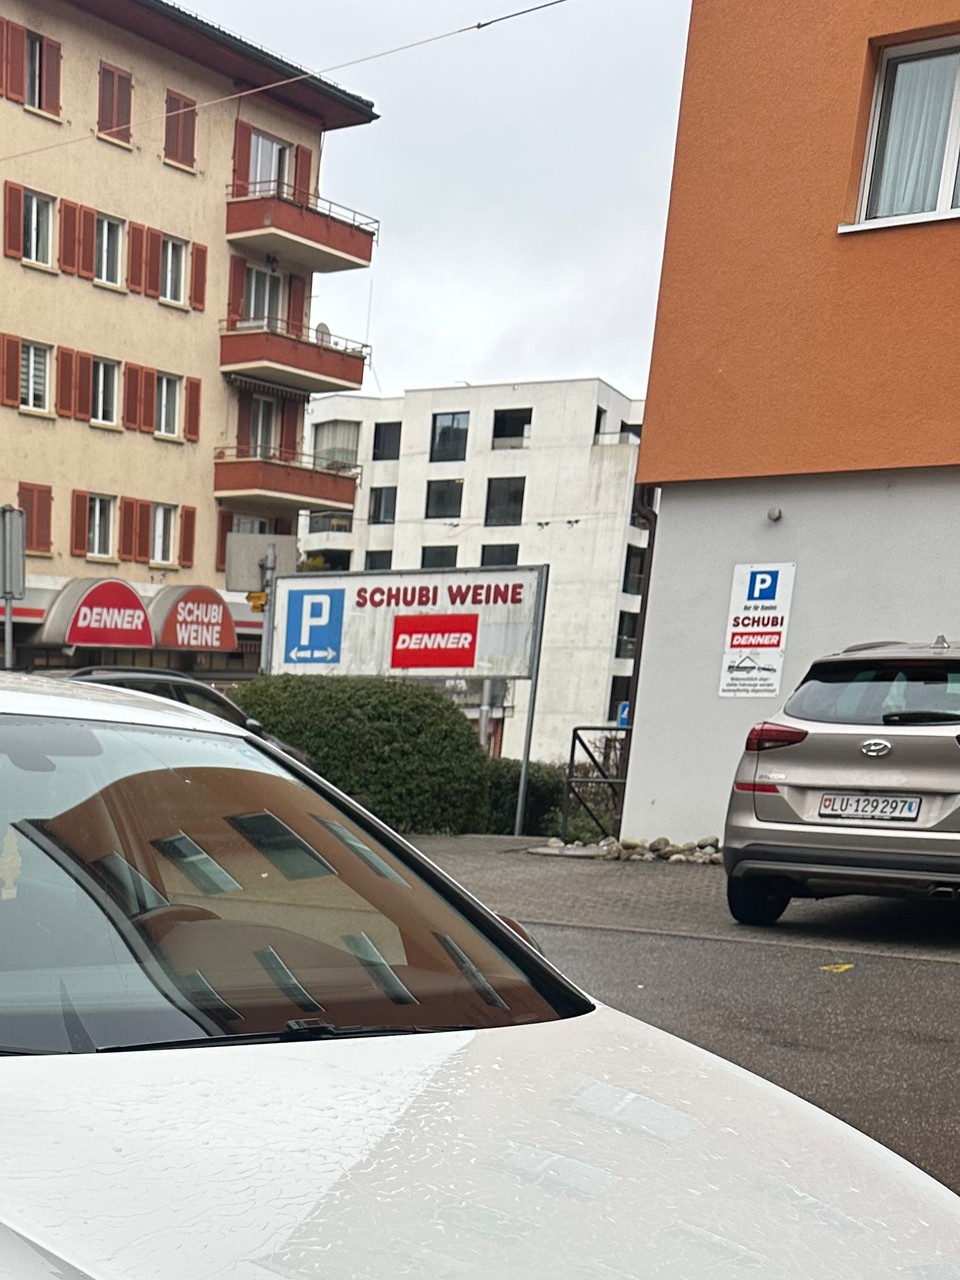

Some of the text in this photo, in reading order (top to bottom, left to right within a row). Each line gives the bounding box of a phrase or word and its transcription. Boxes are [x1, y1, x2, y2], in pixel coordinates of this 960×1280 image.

[355, 583, 524, 608] SCHUBI WEINE
[753, 573, 772, 598] P
[77, 606, 145, 630] DENNER
[176, 602, 224, 623] SCHUBI
[299, 594, 331, 646] P
[732, 615, 785, 628] SCHUBI
[176, 623, 222, 647] WEINE
[395, 632, 473, 650] DENNER
[732, 634, 780, 646] DENNER
